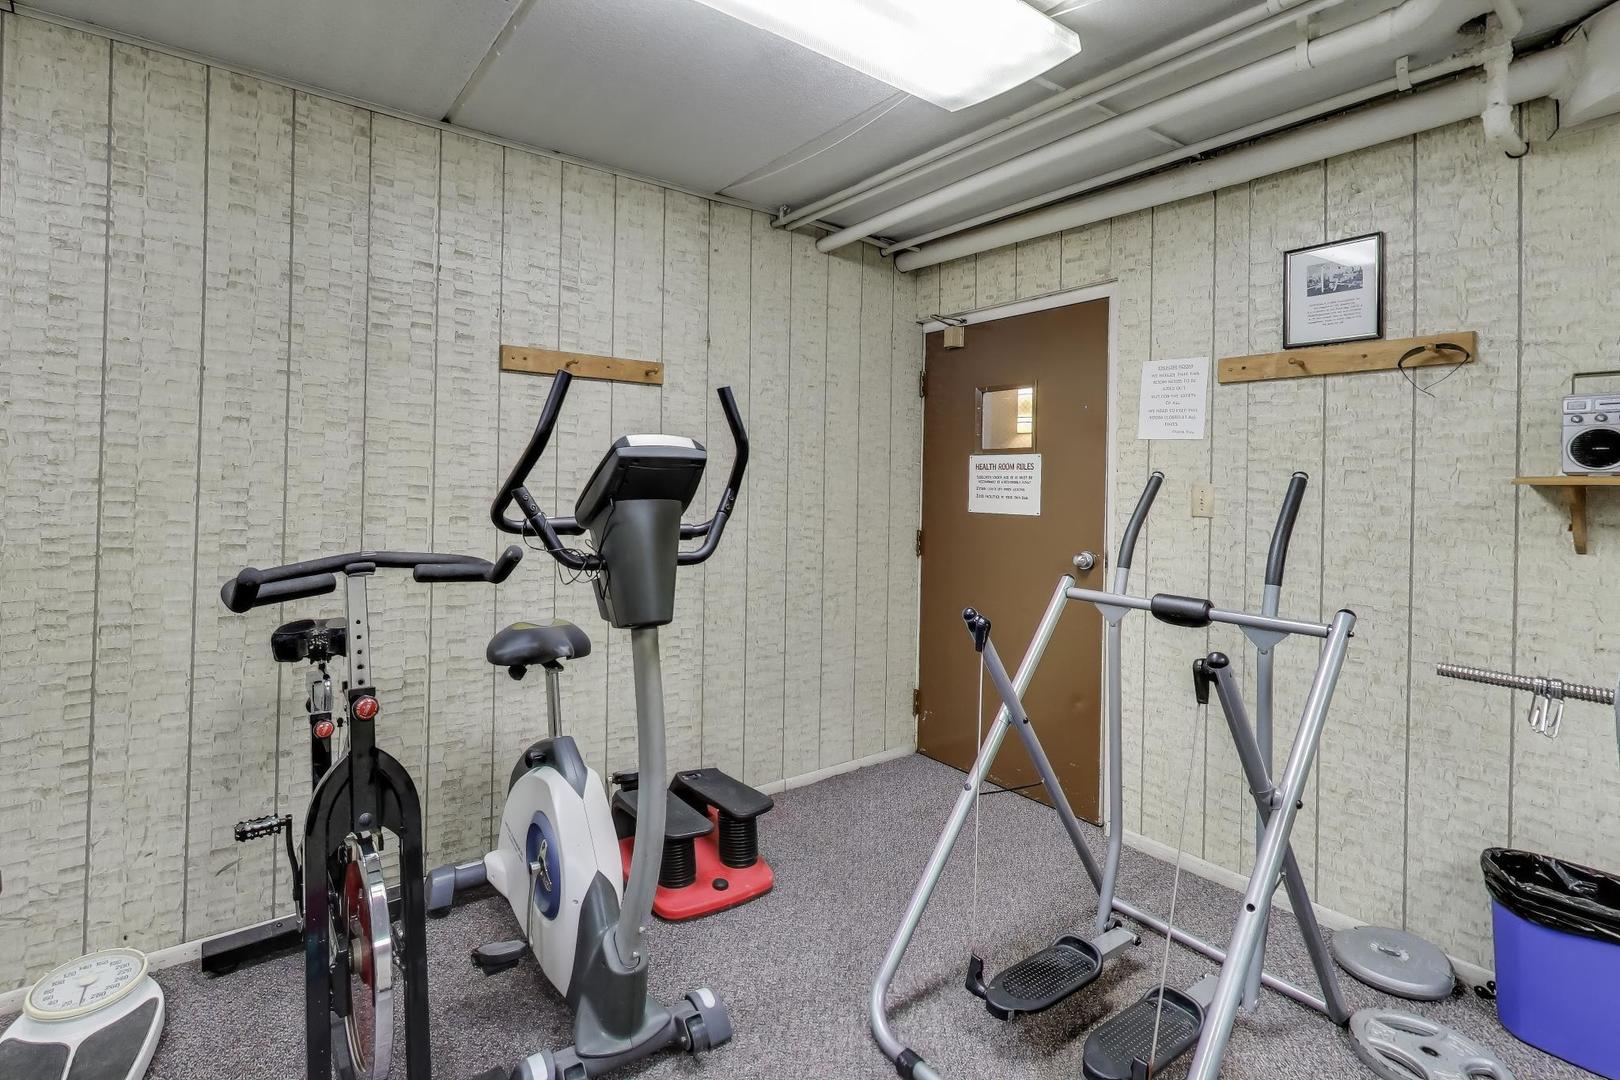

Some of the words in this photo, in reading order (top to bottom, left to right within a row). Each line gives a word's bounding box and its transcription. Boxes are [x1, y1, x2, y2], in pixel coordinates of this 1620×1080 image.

[975, 463, 997, 471] HEALTH
[998, 462, 1015, 471] ROOM
[1016, 462, 1035, 471] RULES
